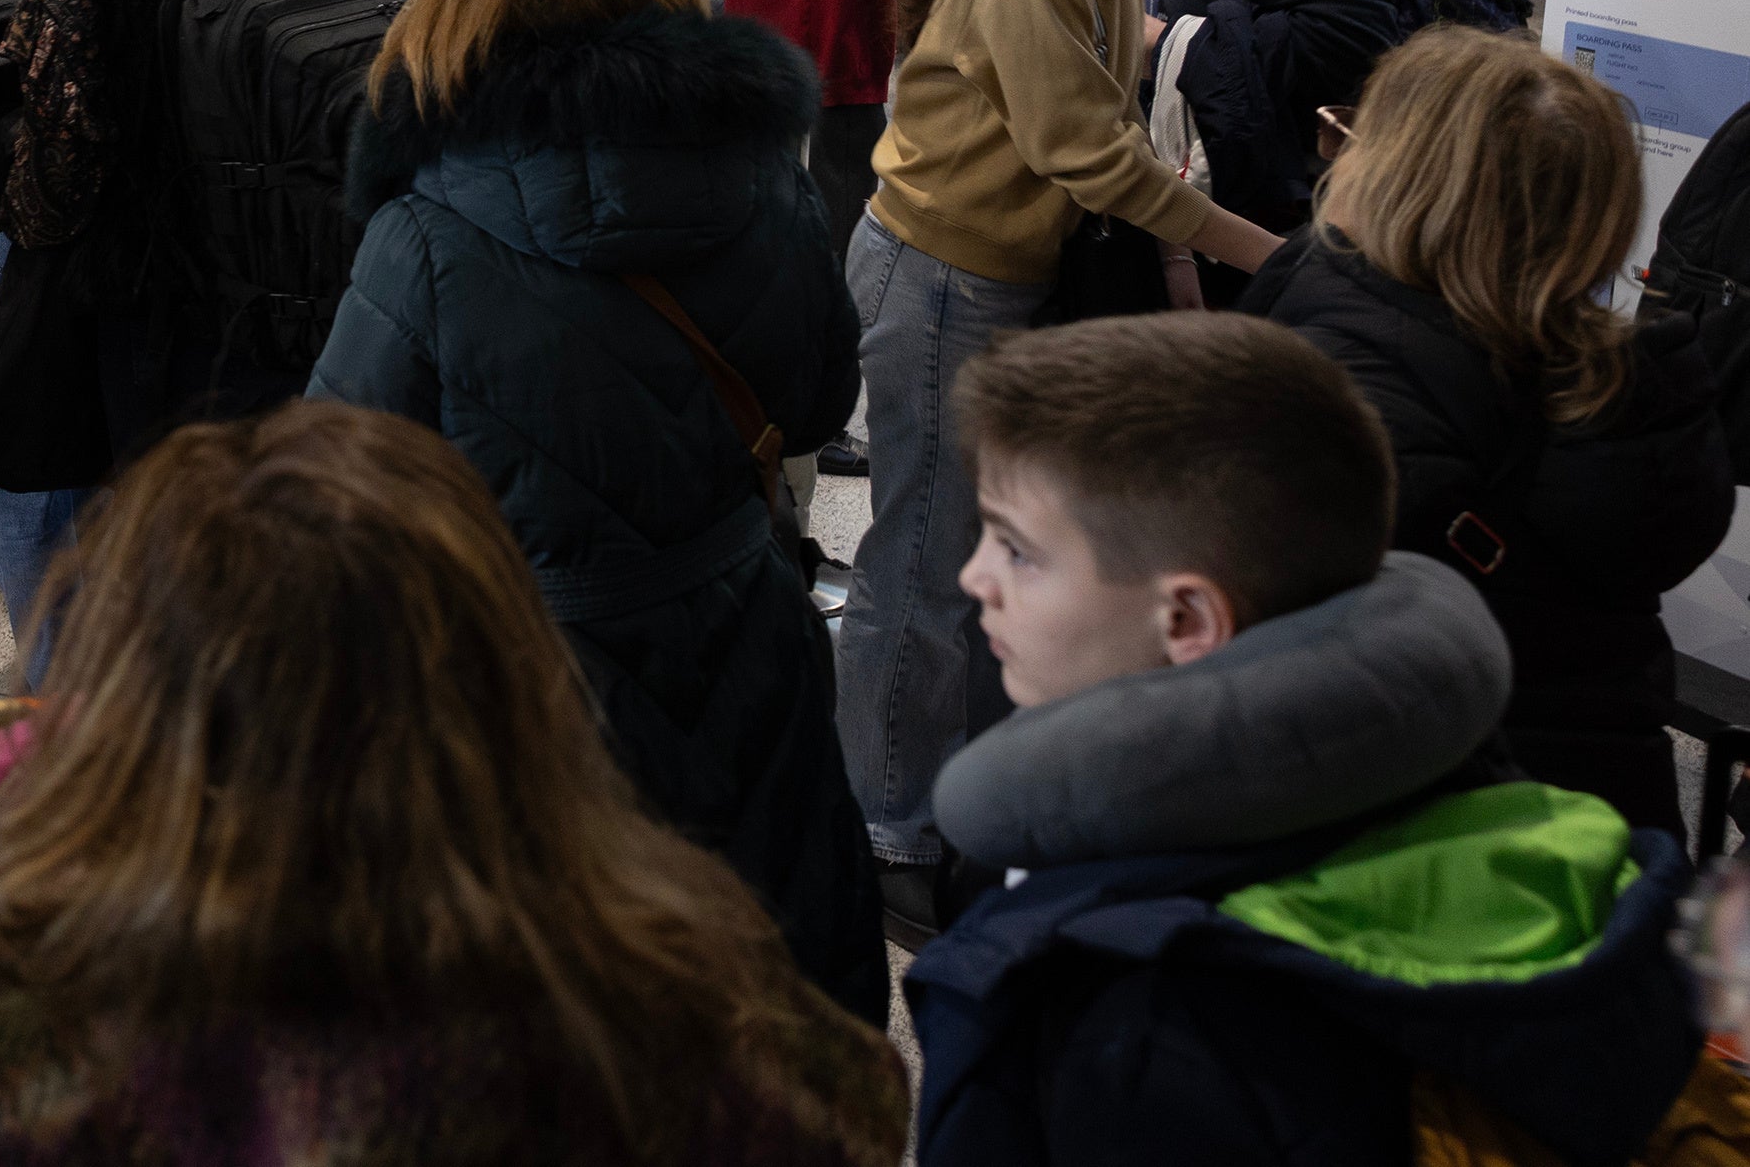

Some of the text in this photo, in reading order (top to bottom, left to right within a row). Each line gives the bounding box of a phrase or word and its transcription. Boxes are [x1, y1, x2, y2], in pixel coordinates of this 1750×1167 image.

[1565, 6, 1638, 27] Printed boarding pass
[1576, 33, 1643, 54] BOARDING PASS
[1657, 148, 1674, 158] here
[1670, 143, 1692, 154] group
